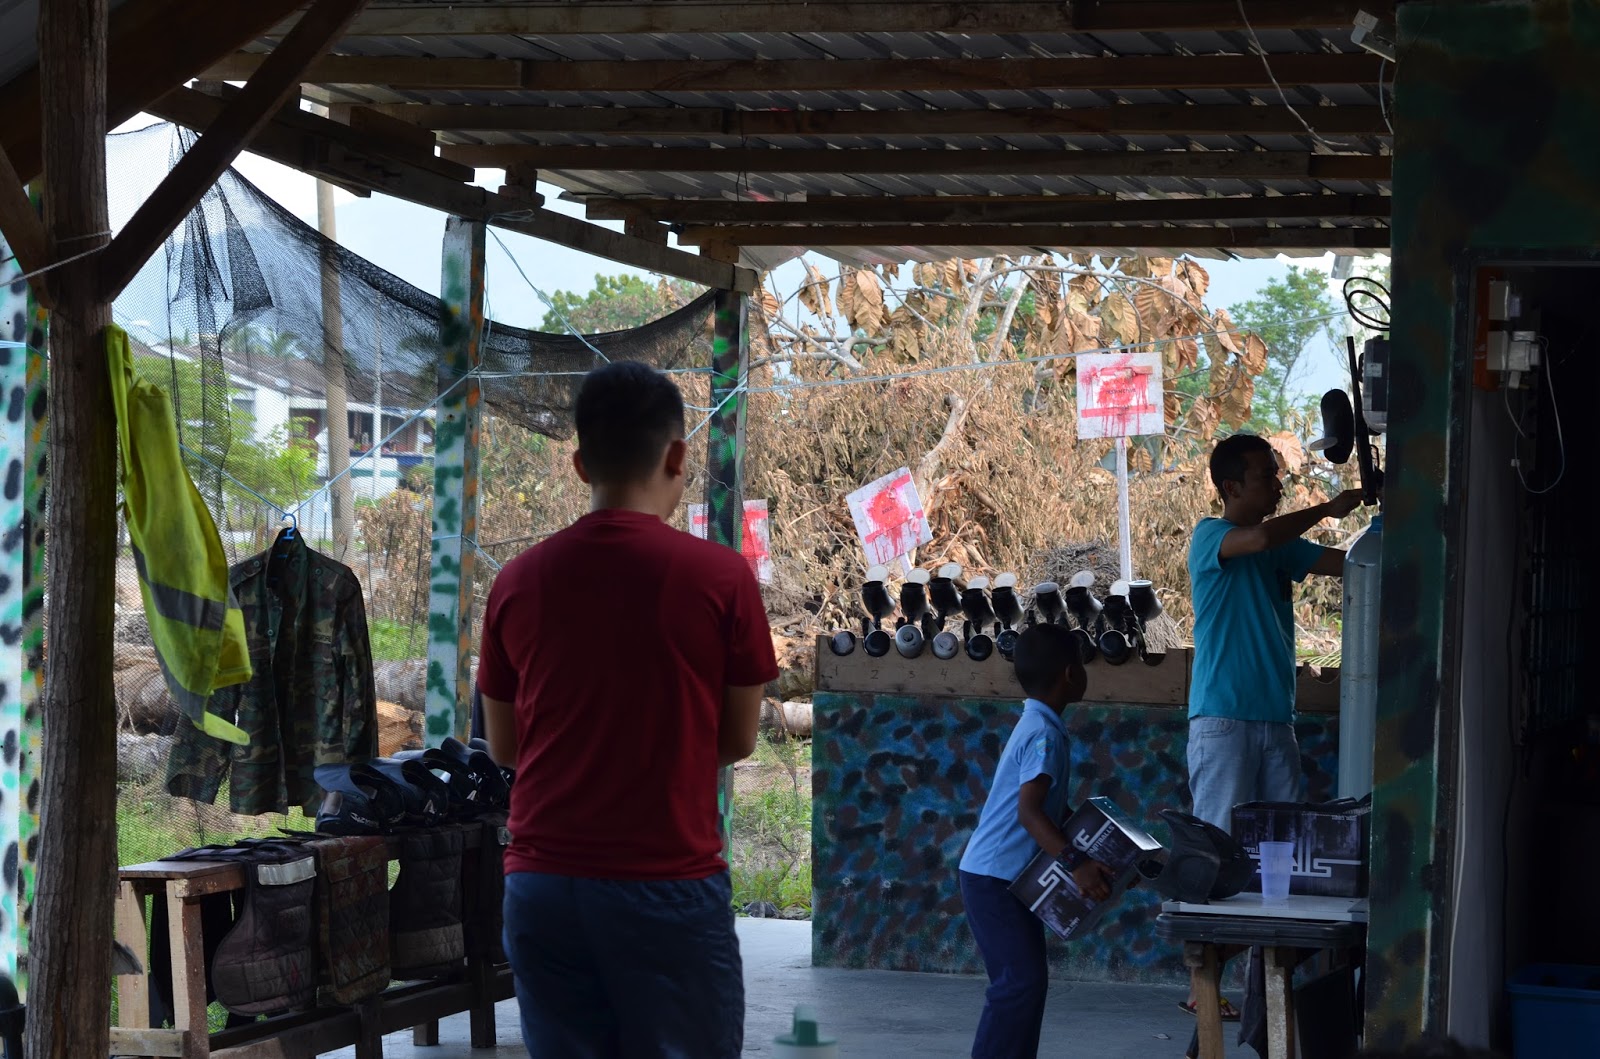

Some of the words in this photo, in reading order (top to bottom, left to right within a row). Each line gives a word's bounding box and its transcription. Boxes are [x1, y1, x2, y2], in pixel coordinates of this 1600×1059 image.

[870, 669, 879, 680] 2
[908, 670, 916, 679] 3
[940, 668, 948, 681] 4
[970, 671, 980, 681] 5
[1029, 820, 1111, 912] STKE
